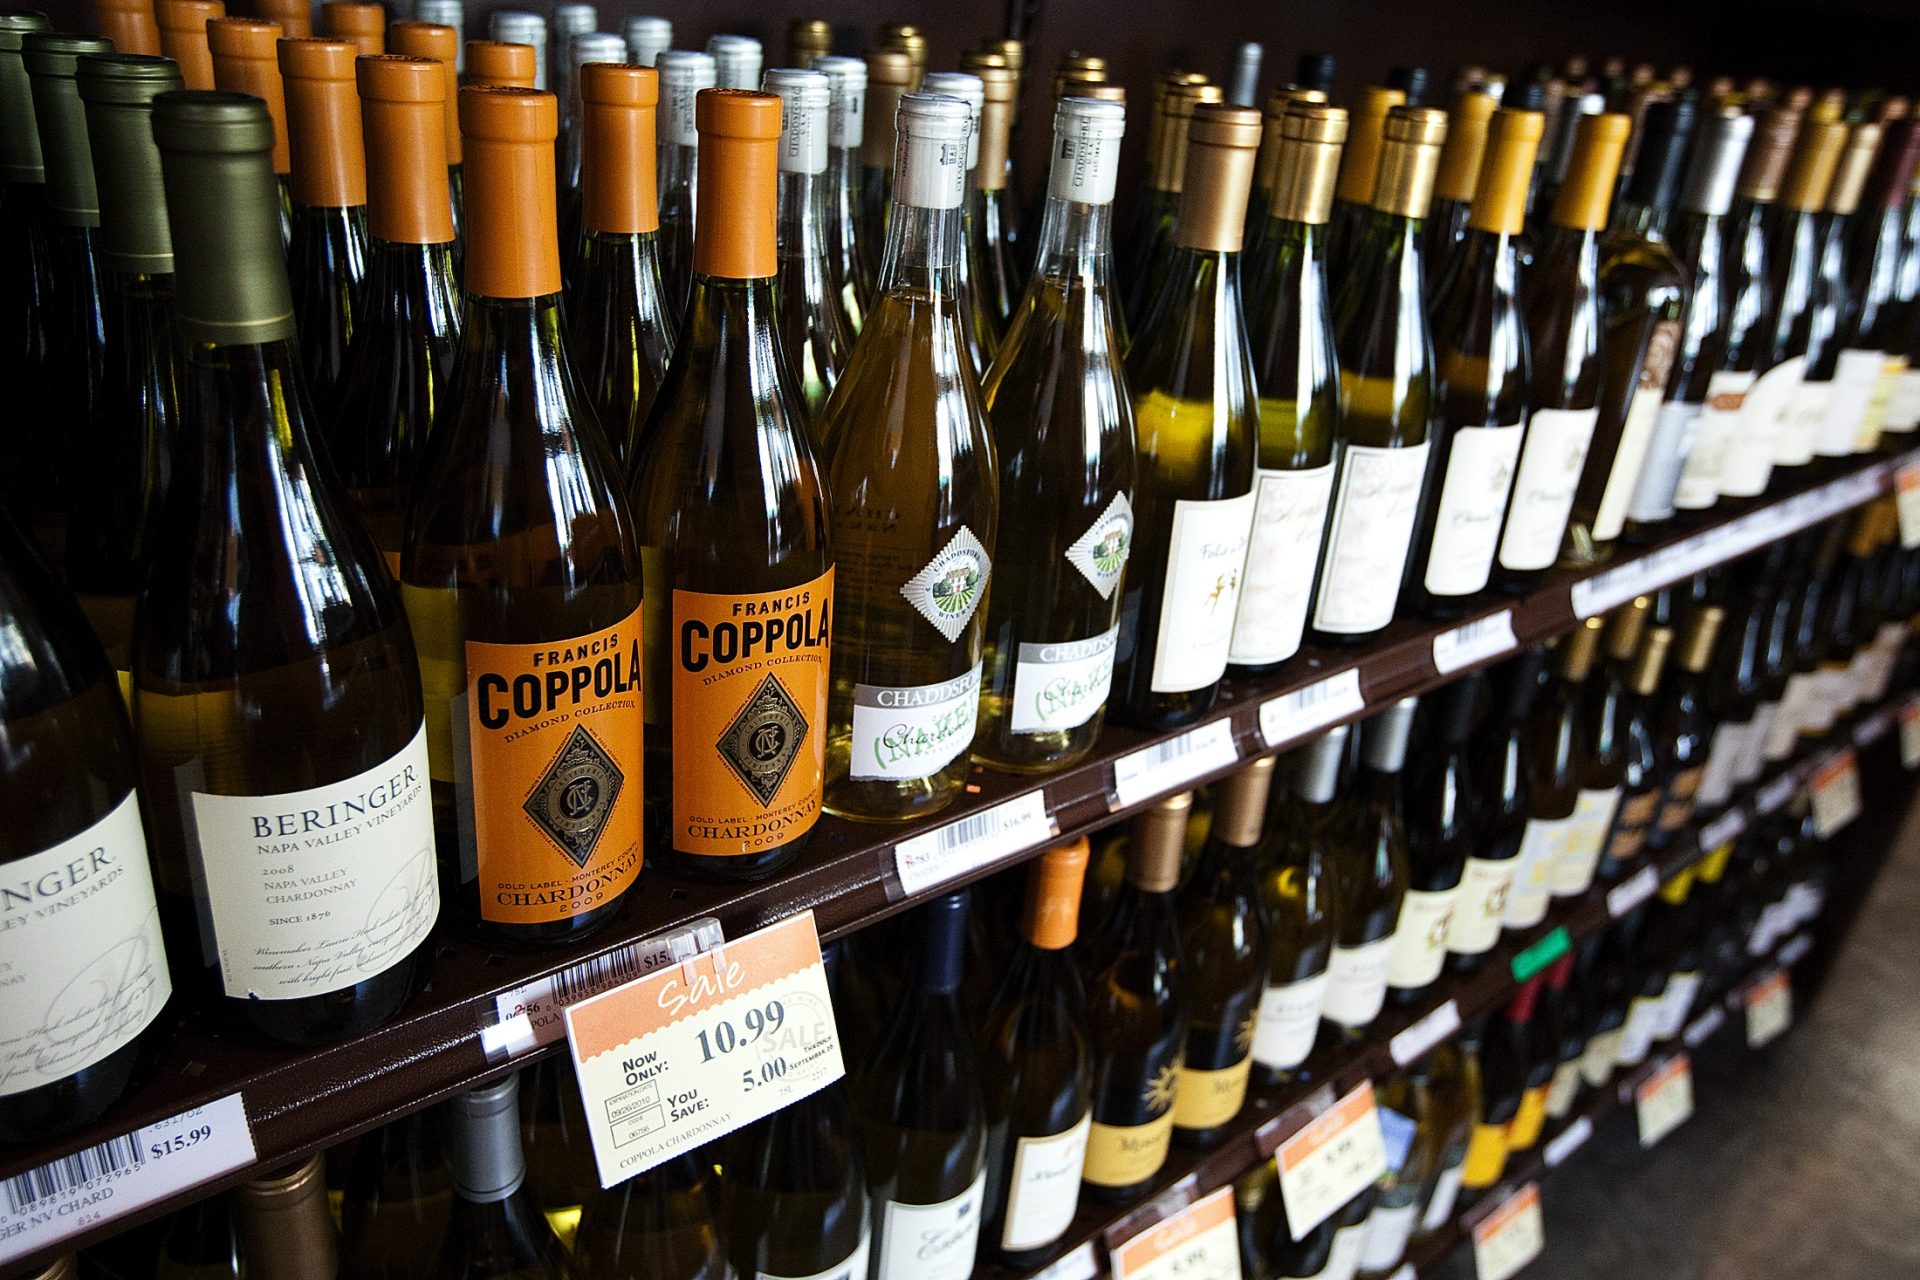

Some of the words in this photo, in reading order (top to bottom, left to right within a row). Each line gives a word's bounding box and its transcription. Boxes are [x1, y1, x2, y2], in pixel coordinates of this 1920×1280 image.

[732, 591, 810, 617] FRANCIS
[533, 633, 618, 668] FRANCIS
[681, 598, 829, 673] COPPOLA
[477, 638, 642, 730] COPPOLA
[703, 662, 762, 686] DIAMOND
[766, 654, 823, 667] COLLECTION
[504, 713, 570, 744] DIAMOND
[574, 699, 636, 718] COLLECTION
[252, 764, 417, 839] BERINGER
[257, 841, 301, 855] NAPA
[304, 825, 363, 849] VALLEY
[365, 782, 422, 830] VINEYARDS
[687, 796, 819, 839] CHARDONNAY
[689, 815, 714, 824] GOLD
[718, 815, 748, 824] LABEL
[756, 804, 796, 820] MONTEREY
[0, 846, 113, 912] NGER
[262, 864, 295, 876] 2008
[264, 880, 297, 890] NAPA
[300, 867, 348, 887] VALLEY
[497, 882, 525, 890] GOLD
[530, 879, 562, 890] LABEL
[571, 861, 615, 883] MONTEREY
[497, 848, 639, 905] CHARDONNAY
[37, 865, 124, 920] VINEYARDS
[266, 878, 357, 904] CHARDONNAY
[559, 892, 604, 913] 2009
[269, 915, 303, 926] SINCE
[306, 910, 331, 922] 1876
[657, 959, 746, 1016] Sale
[529, 1013, 562, 1030] POLA
[694, 1000, 785, 1064] 10.99
[762, 1021, 826, 1054] SALE
[742, 1056, 787, 1092] 5.00
[611, 1096, 651, 1119] 09/26/2010
[151, 1124, 212, 1159] $15.99
[619, 1144, 664, 1169] COPPOLA
[665, 1111, 732, 1148] CHARDONNAY
[86, 1163, 142, 1190] 072965
[0, 1221, 27, 1242] GER
[31, 1209, 54, 1229] NV
[57, 1186, 115, 1217] CHARD
